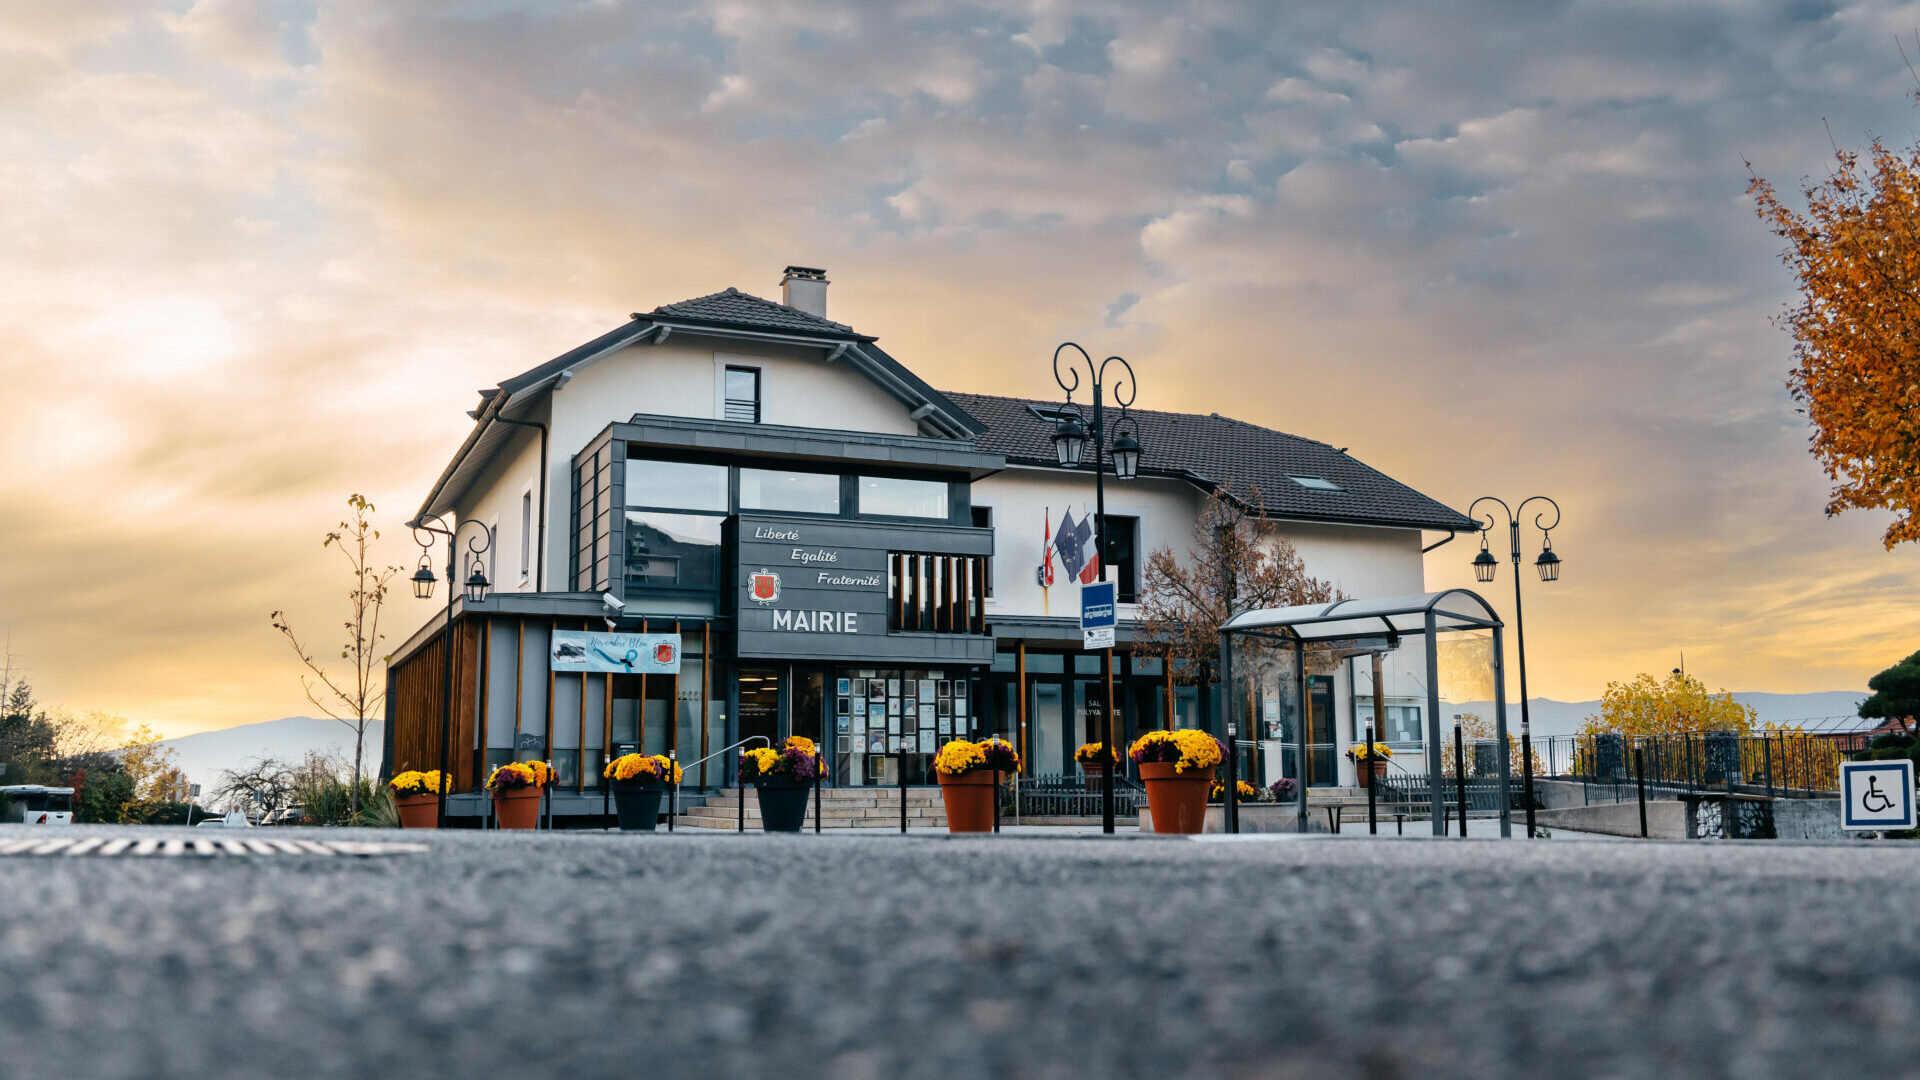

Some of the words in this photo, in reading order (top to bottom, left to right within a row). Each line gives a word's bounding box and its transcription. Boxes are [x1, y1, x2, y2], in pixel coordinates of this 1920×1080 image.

[755, 526, 800, 541] Liberté
[791, 548, 838, 564] Egalité
[817, 572, 881, 586] Fraternité
[773, 609, 858, 633] MAIRIE
